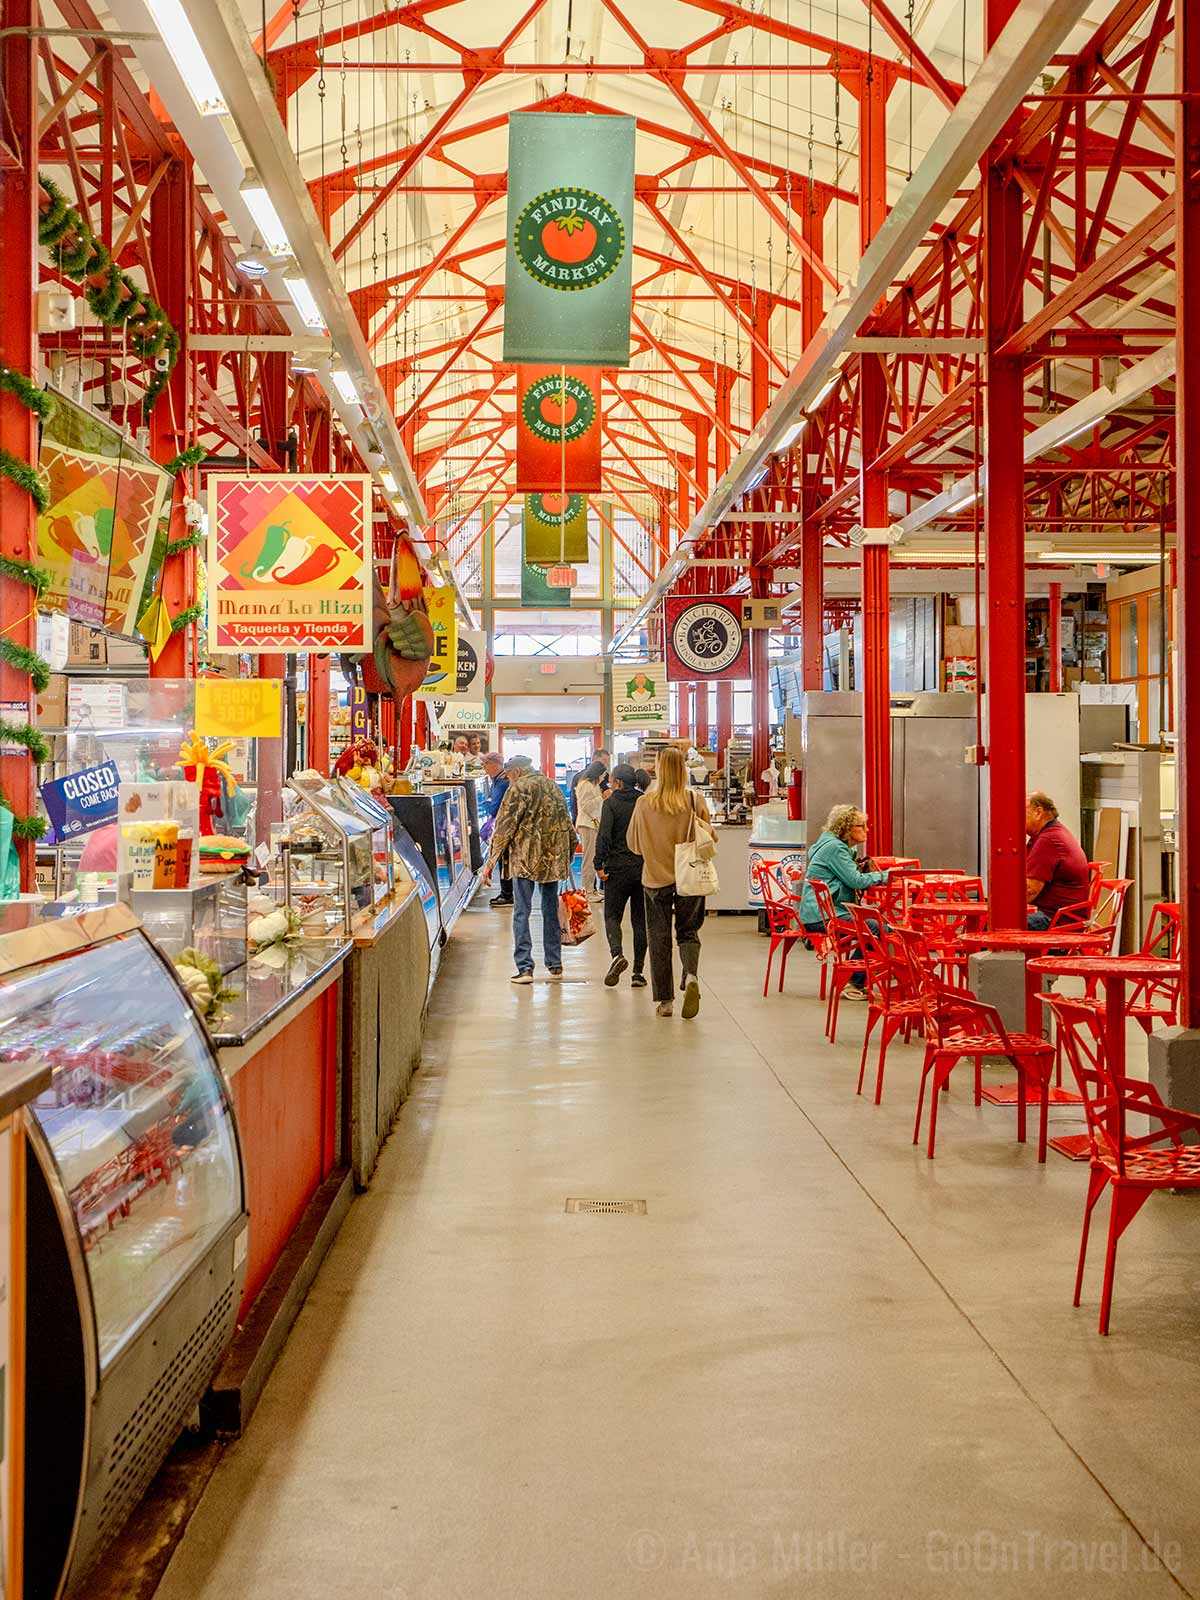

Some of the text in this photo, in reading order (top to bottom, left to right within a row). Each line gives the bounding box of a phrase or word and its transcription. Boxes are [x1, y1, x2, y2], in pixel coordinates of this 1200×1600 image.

[530, 196, 612, 226] FINDLAY
[532, 253, 607, 280] MARKET
[532, 380, 587, 399] FINDLAY
[534, 418, 585, 436] MARKET
[551, 570, 573, 586] EXIT
[293, 625, 301, 636] y
[303, 623, 348, 634] Tienda
[679, 641, 737, 668] FINDLAY MARKET
[457, 708, 481, 723] dojo
[616, 704, 652, 713] Colonel
[63, 767, 115, 800] CLOSED
[80, 786, 120, 809] COME BACK
